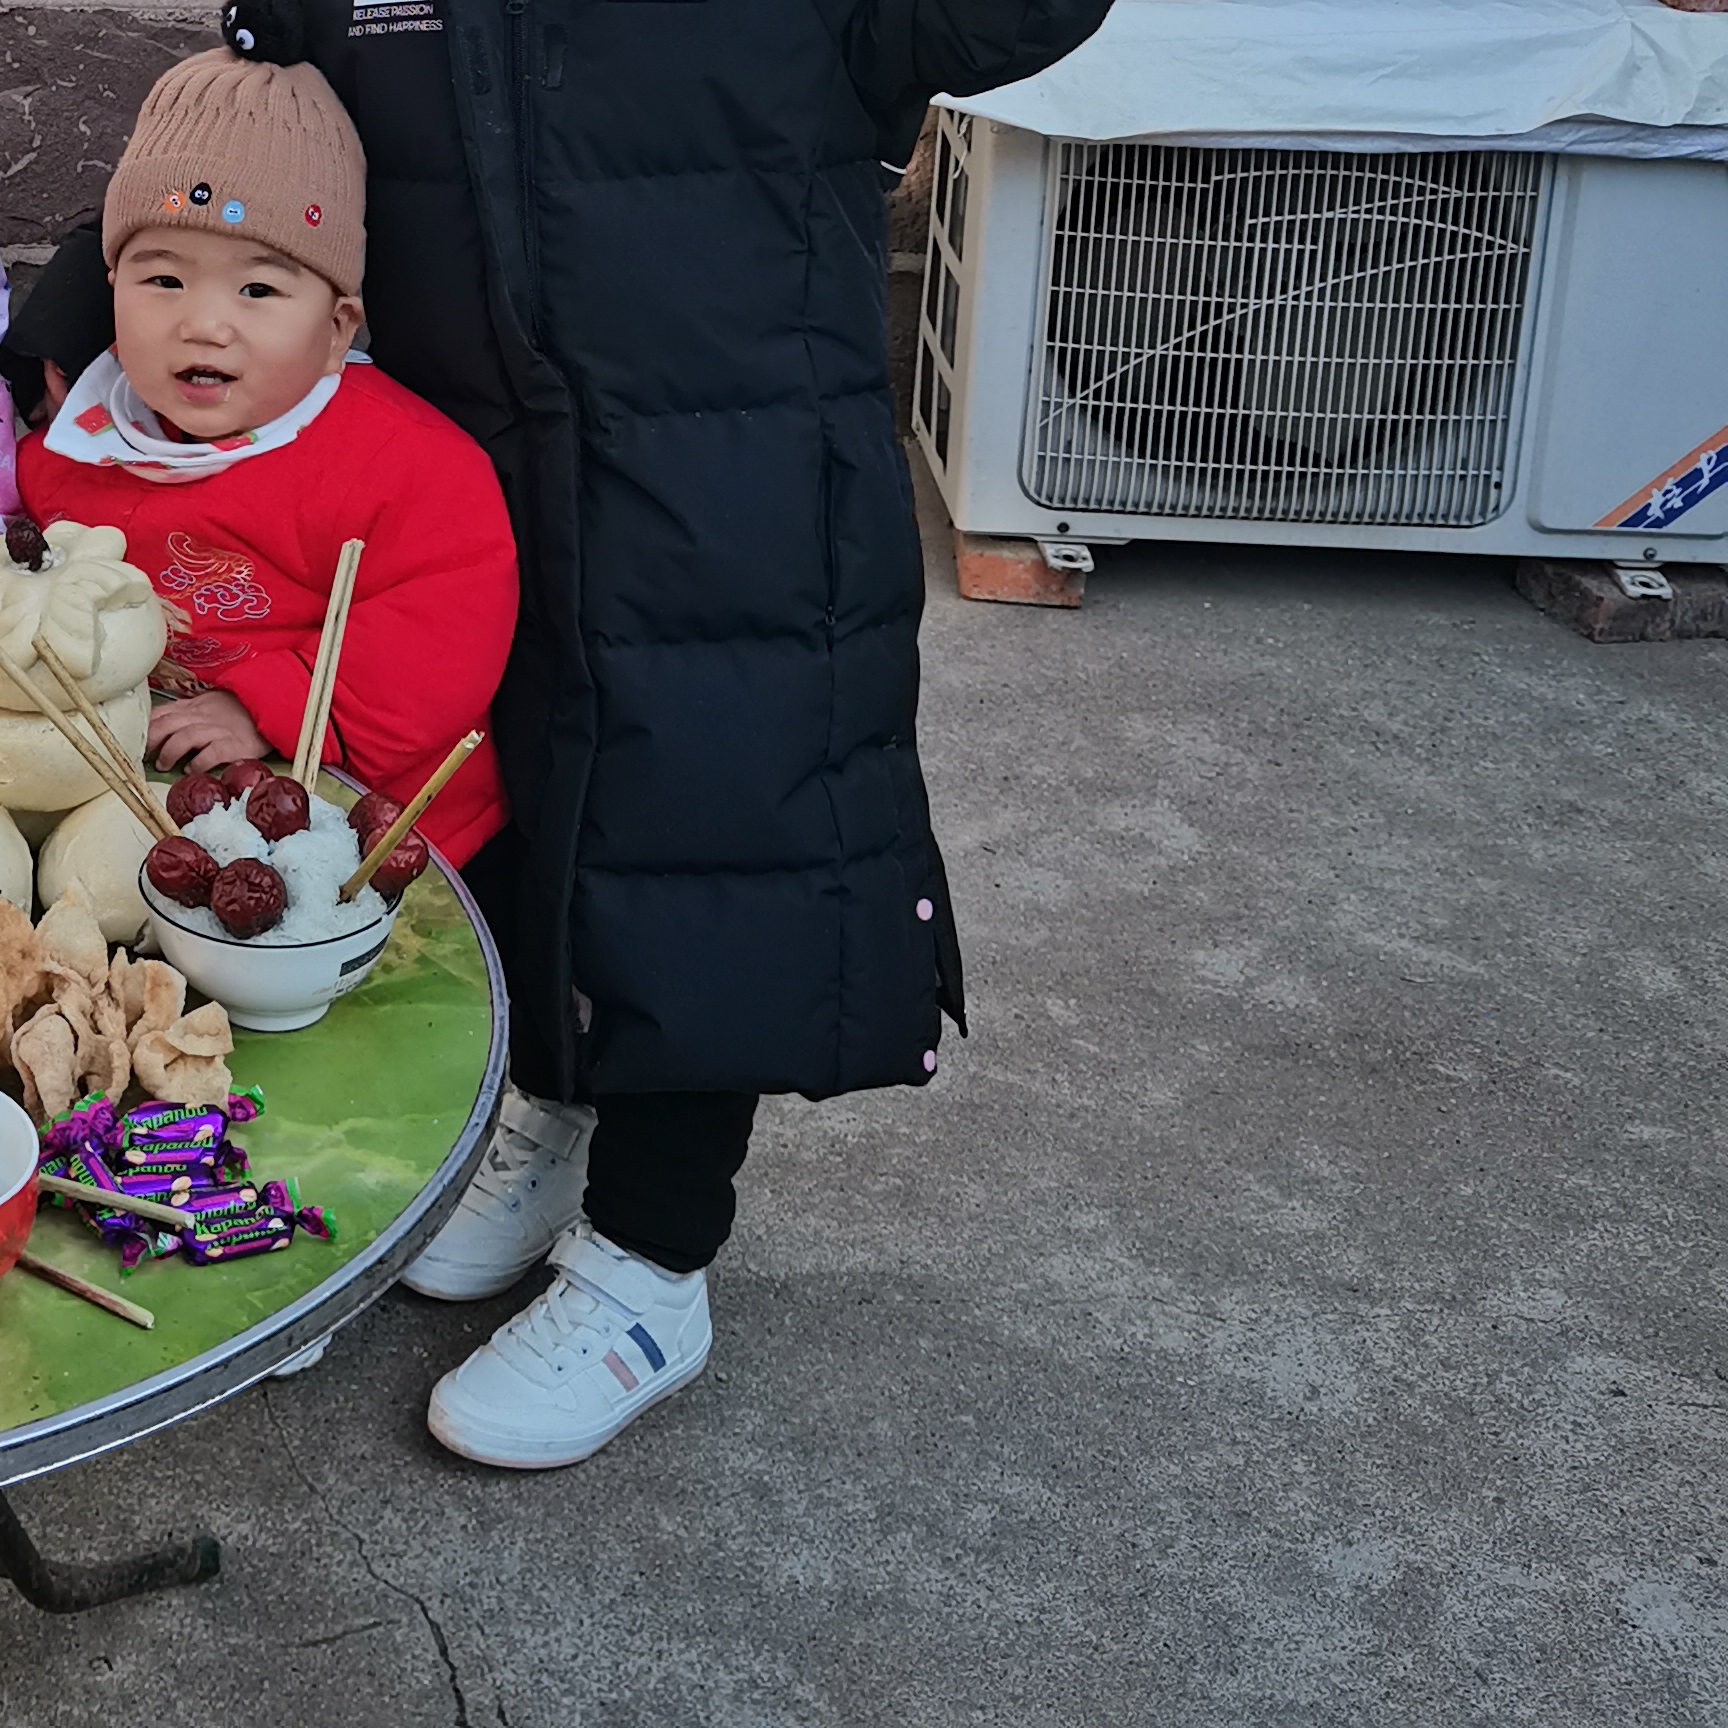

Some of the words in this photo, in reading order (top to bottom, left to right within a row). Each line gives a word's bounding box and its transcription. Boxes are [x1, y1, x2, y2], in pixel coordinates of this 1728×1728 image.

[391, 3, 434, 17] PASSION
[347, 25, 364, 38] AND
[365, 22, 388, 34] FIND
[388, 19, 443, 33] HAPPINESS
